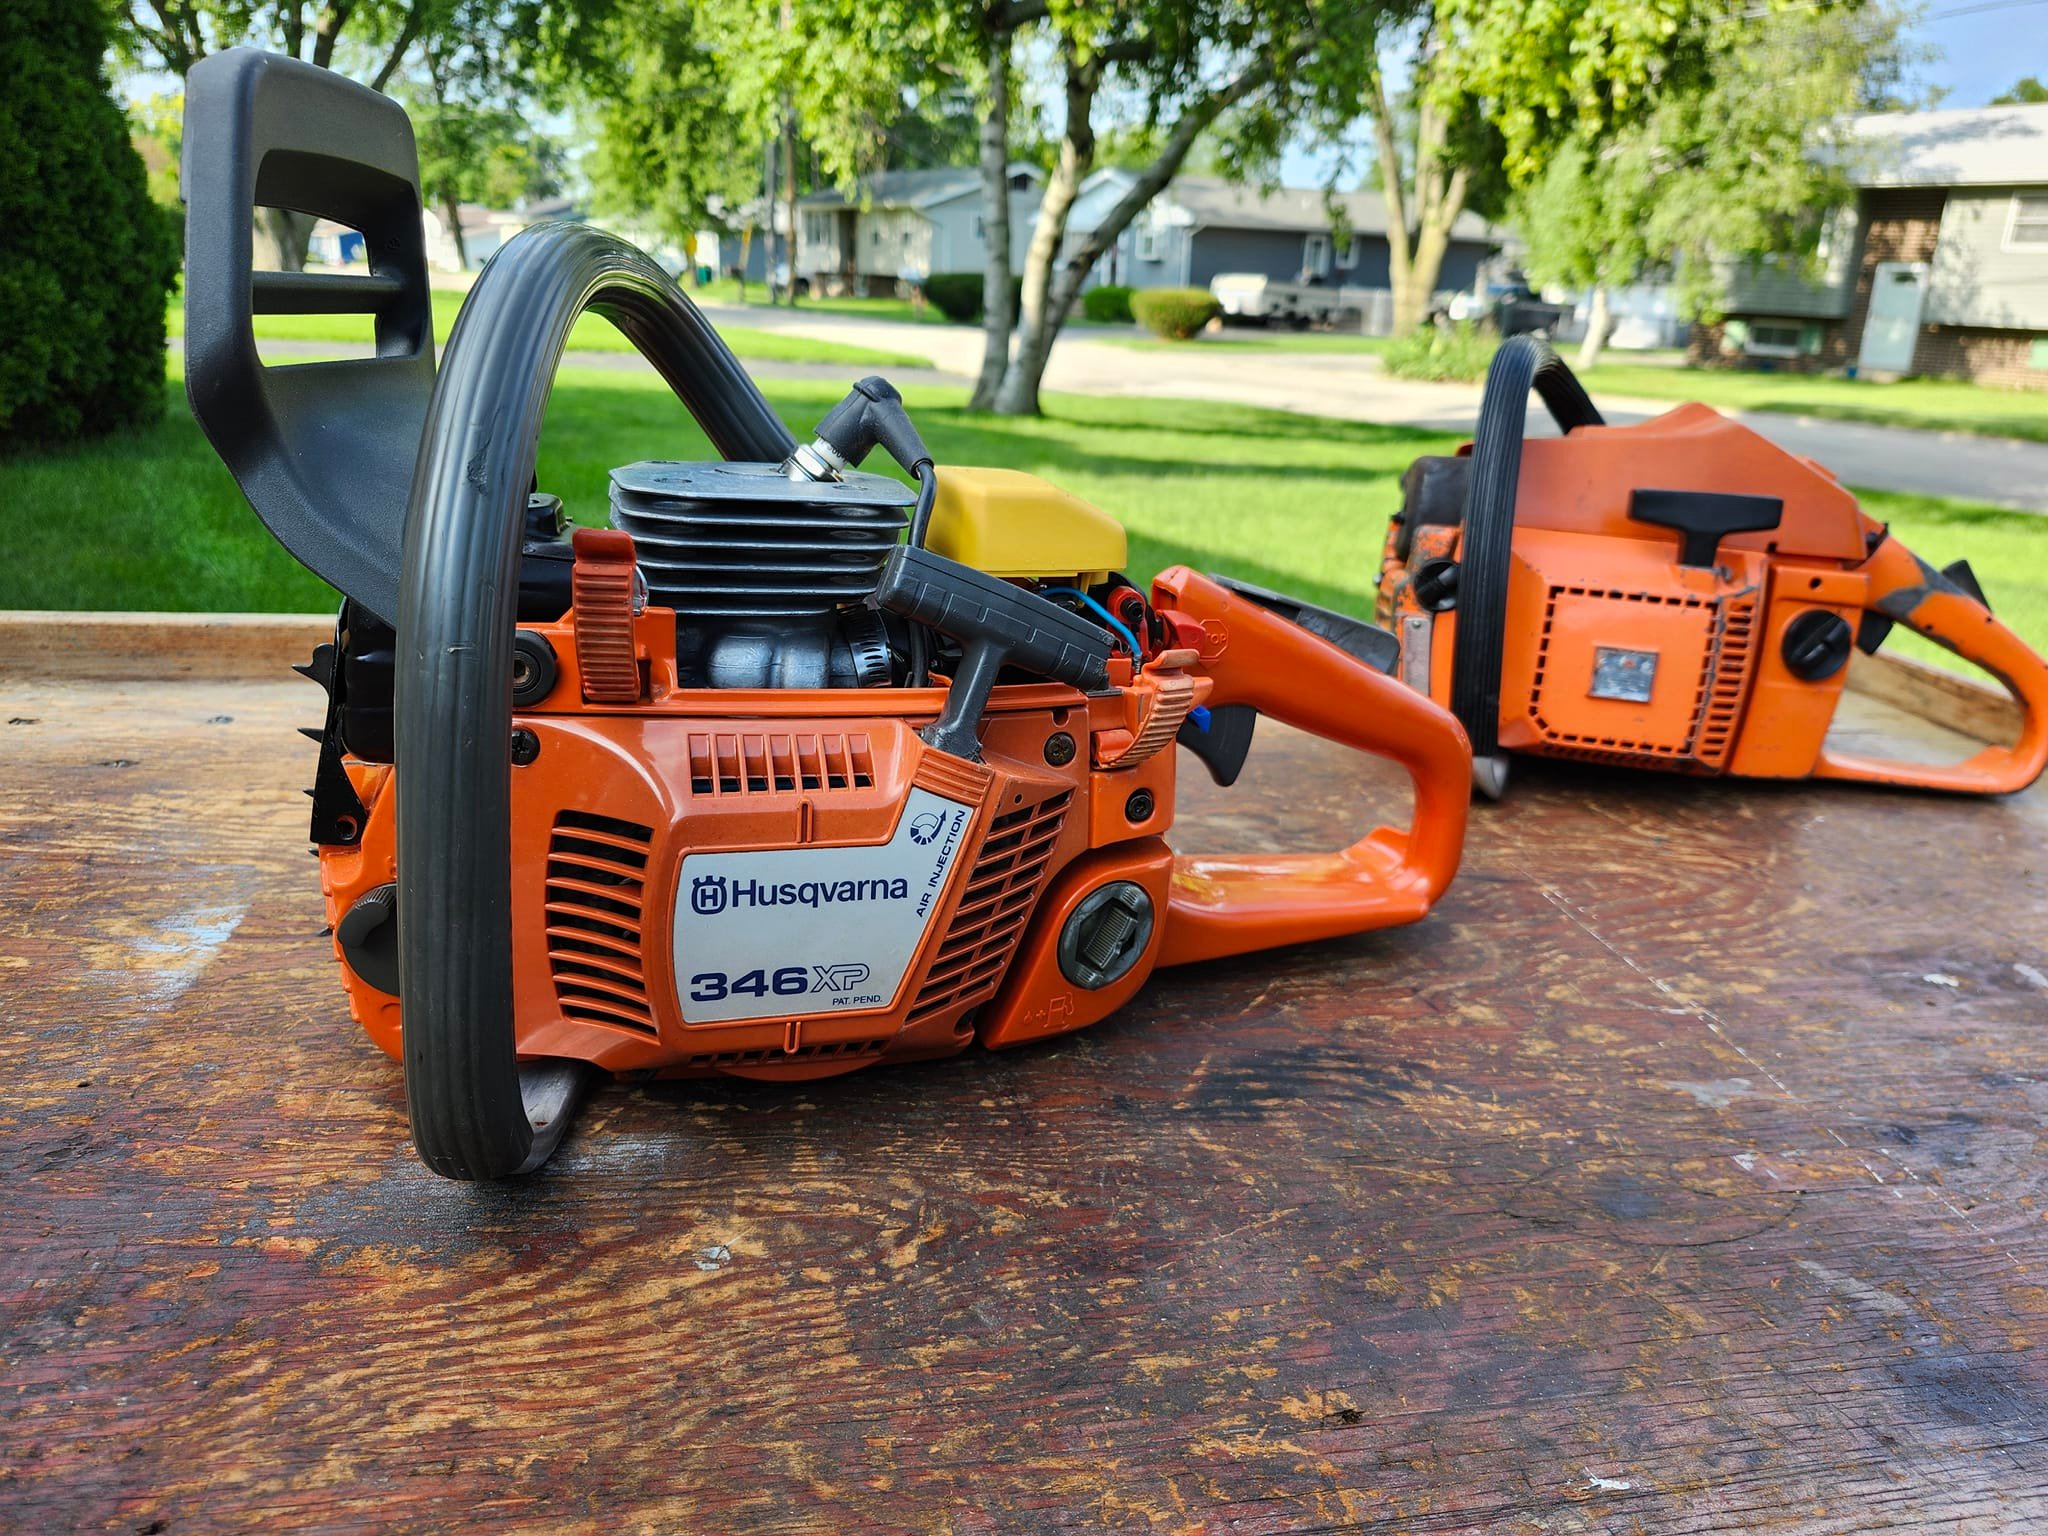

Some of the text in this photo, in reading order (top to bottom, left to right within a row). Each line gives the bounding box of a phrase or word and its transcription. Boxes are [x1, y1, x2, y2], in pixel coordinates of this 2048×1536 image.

[916, 810, 966, 917] AIR INJECTION
[732, 877, 909, 909] Husqvarna
[832, 994, 883, 1006] PAT. PEND.
